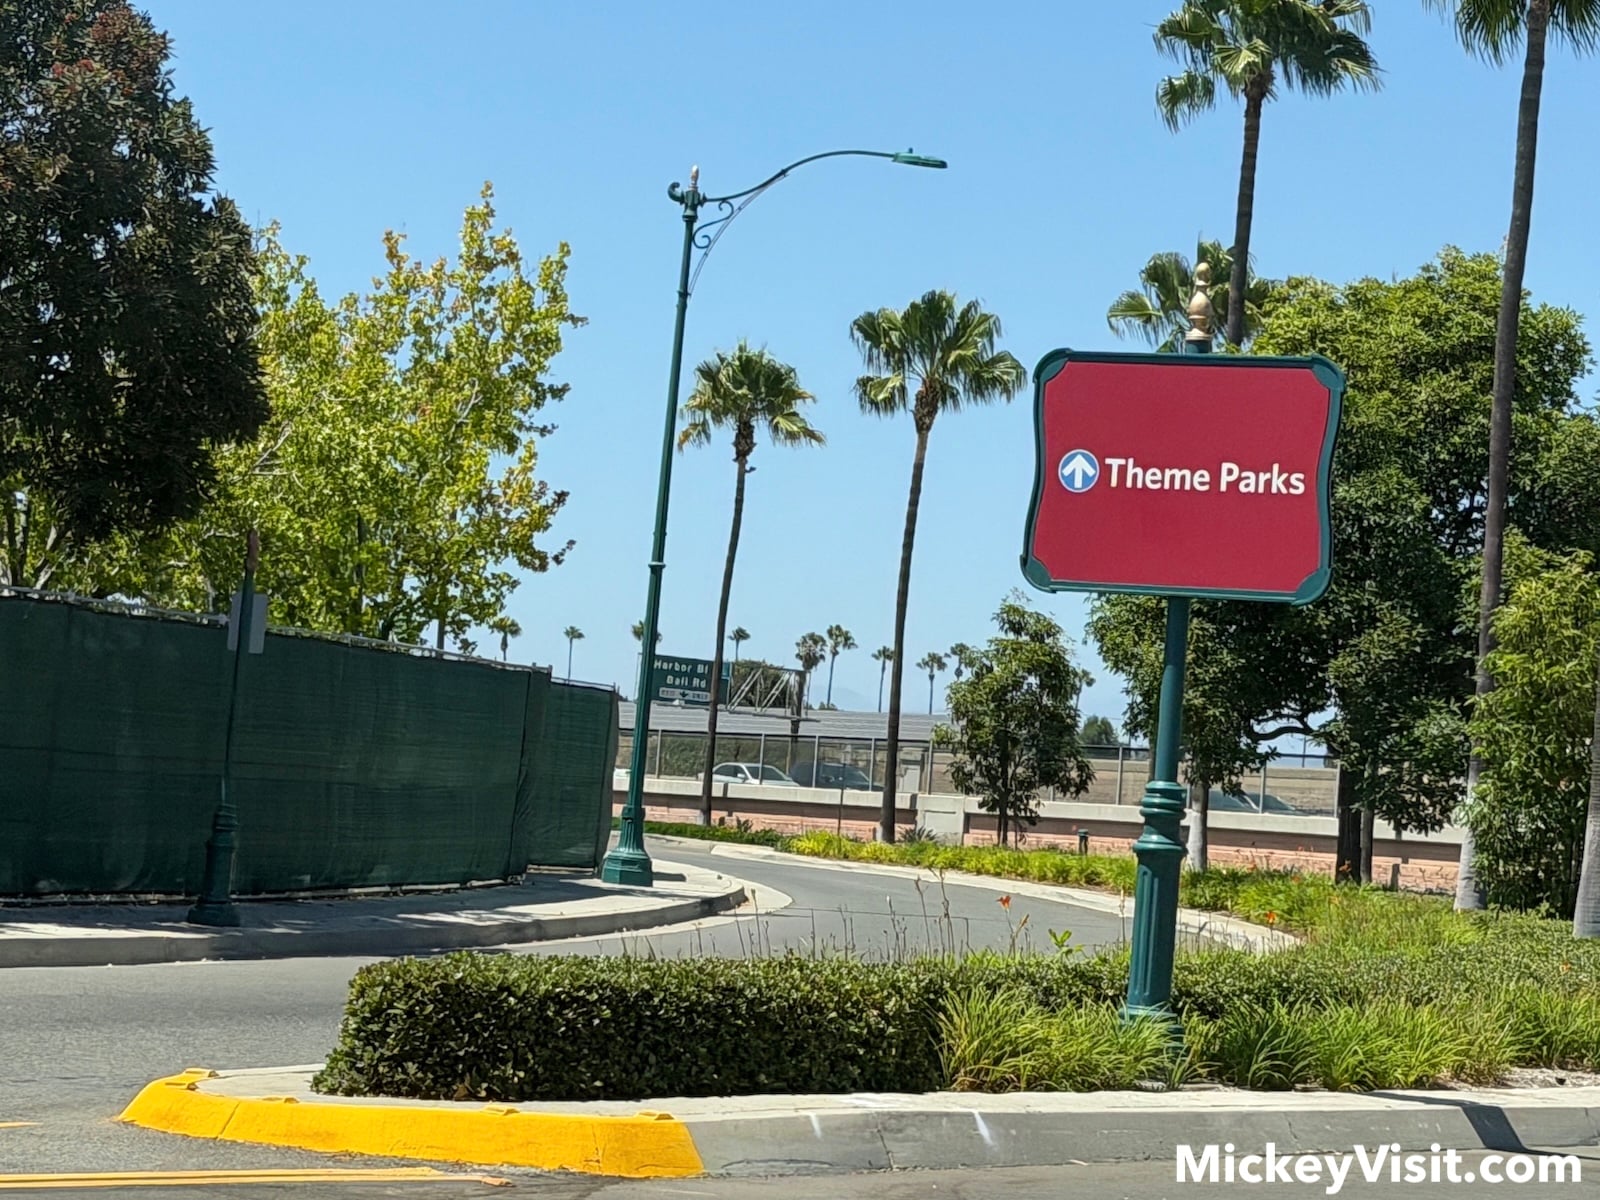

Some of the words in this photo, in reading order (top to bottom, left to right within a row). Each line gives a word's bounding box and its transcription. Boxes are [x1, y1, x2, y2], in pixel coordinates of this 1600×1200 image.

[1105, 457, 1211, 491] Theme
[1219, 462, 1306, 495] Parks
[654, 659, 692, 673] Harbor
[666, 675, 689, 686] Ball
[692, 677, 706, 688] Rd
